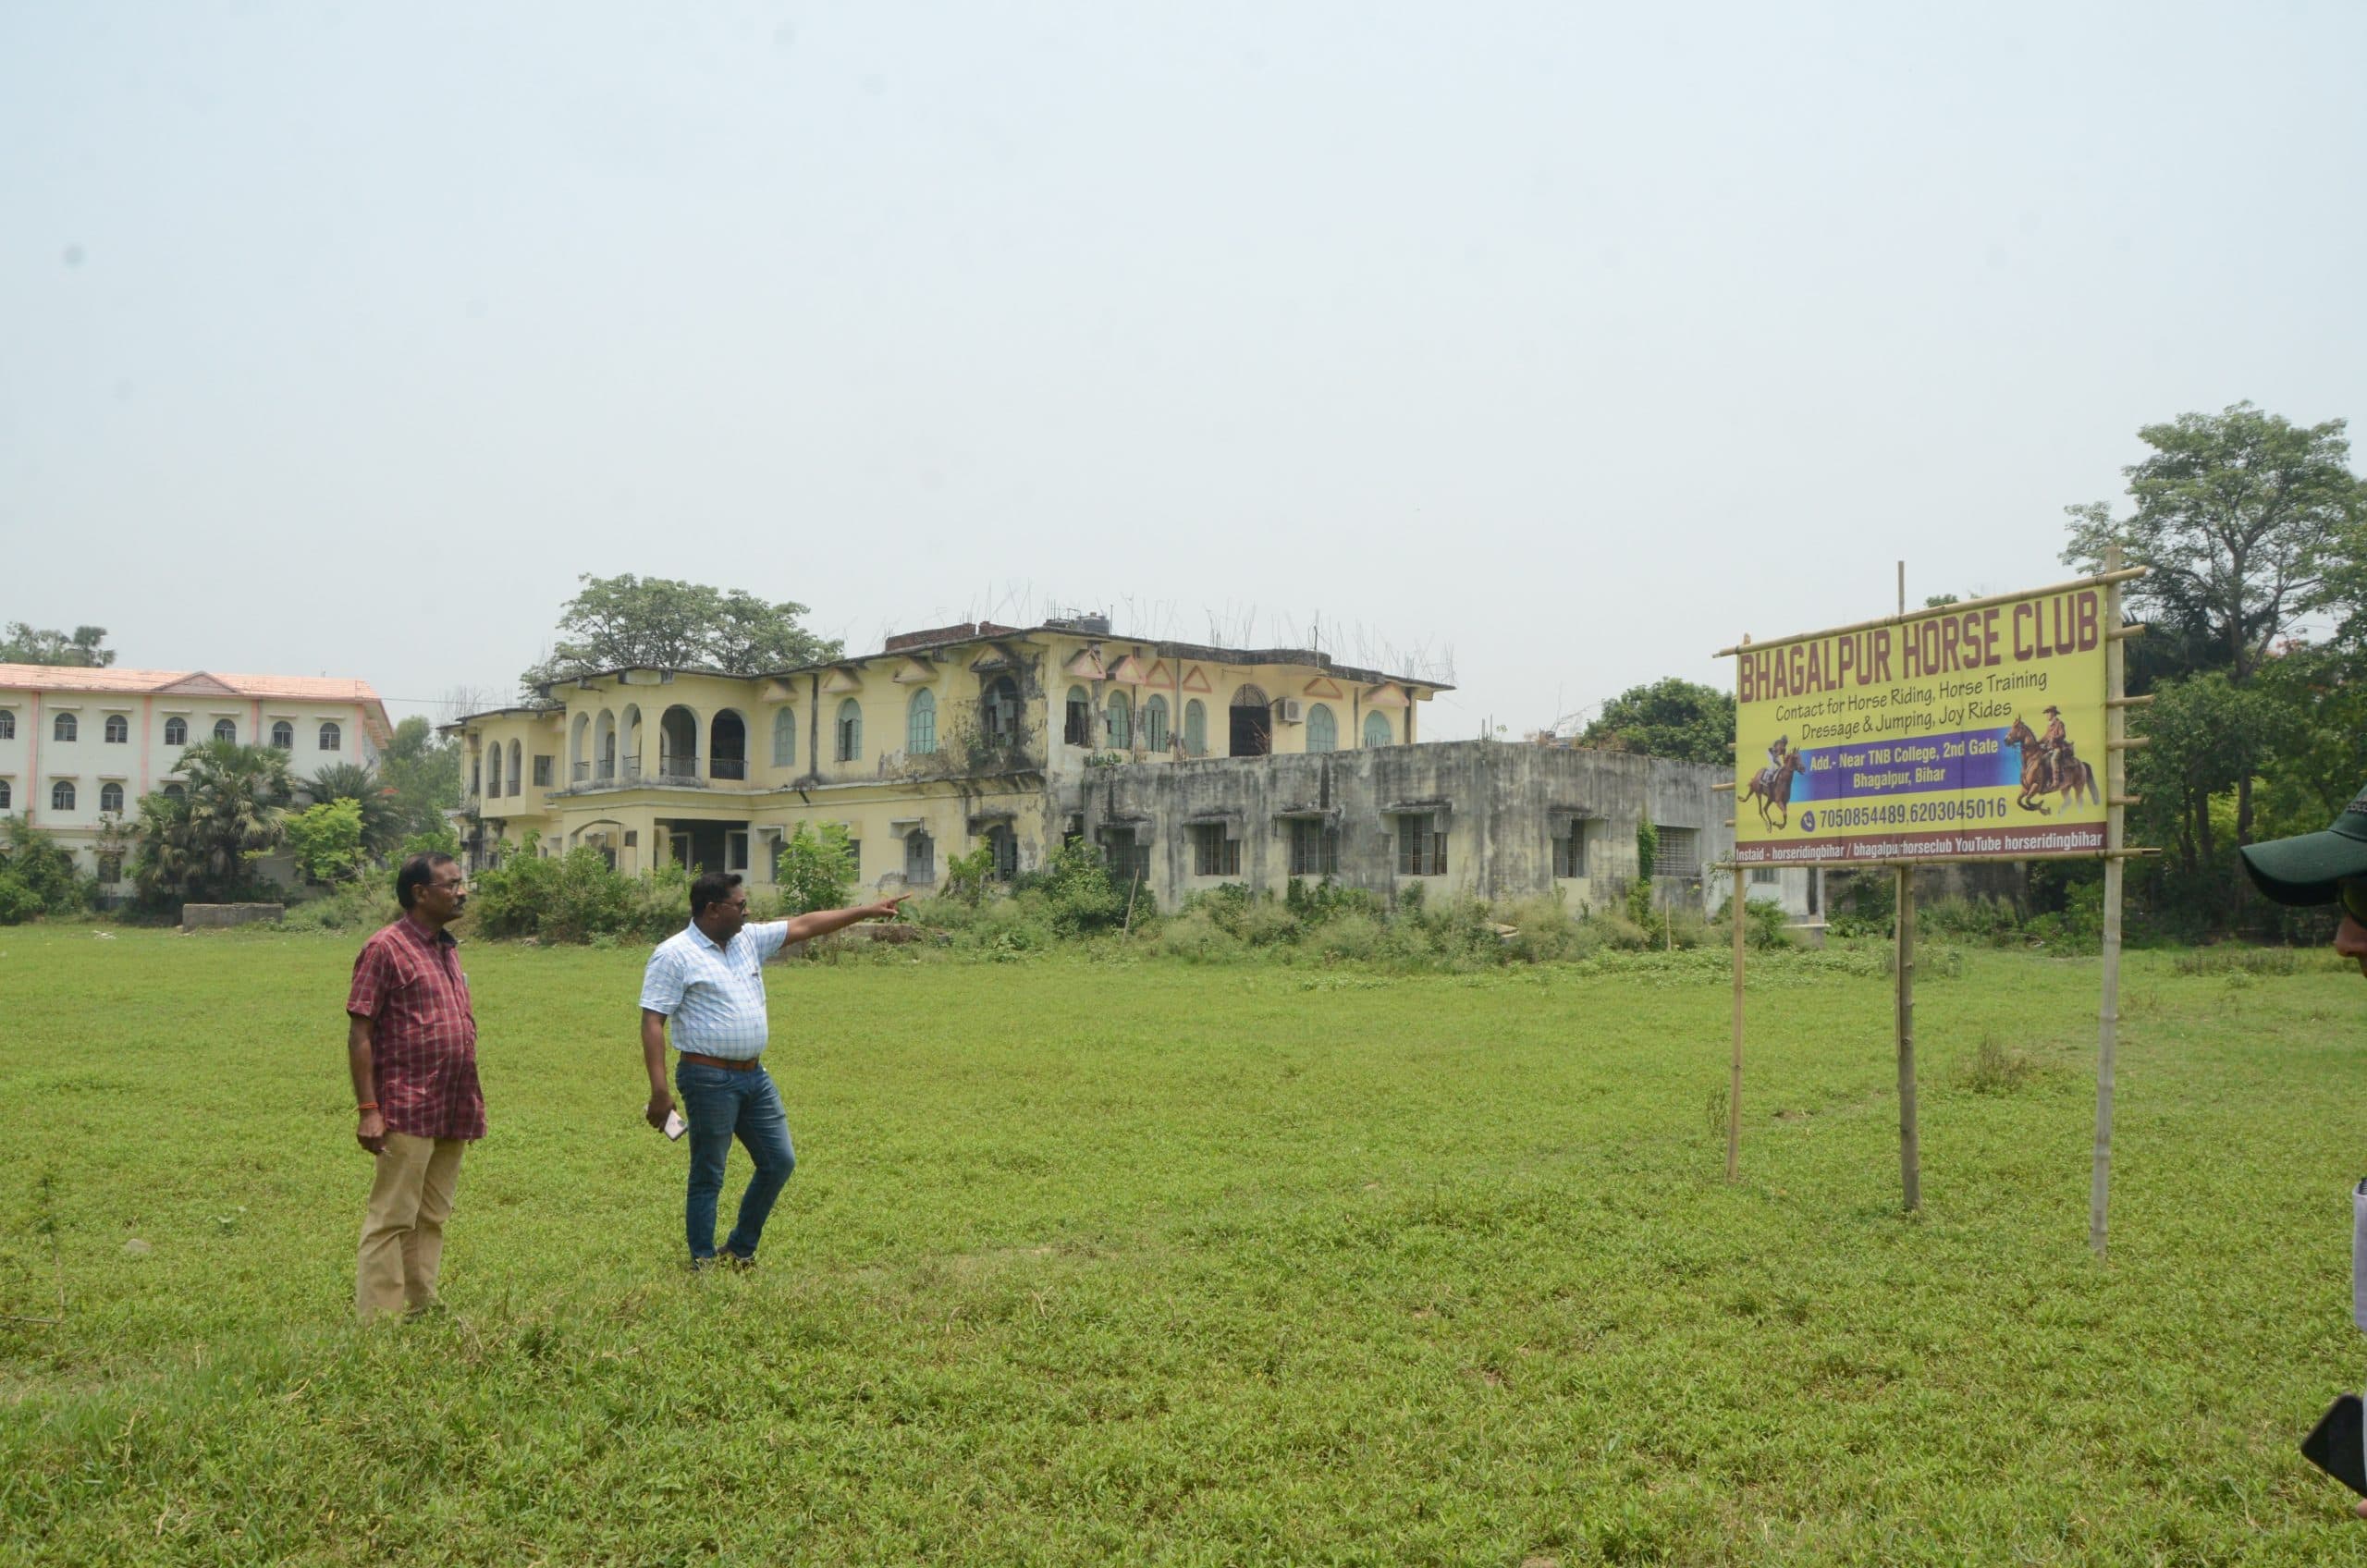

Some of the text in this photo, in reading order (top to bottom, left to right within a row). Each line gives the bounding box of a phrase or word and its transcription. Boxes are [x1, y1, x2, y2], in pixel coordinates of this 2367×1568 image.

[1740, 591, 2098, 703] BHAGALPUR HORSE CLUB
[1776, 670, 2047, 721] Contact for Horse Riding, Horse Training
[1802, 700, 2012, 741] Dressage & Jumping, Joy Rides
[1839, 751, 1865, 768] Near
[1868, 748, 1891, 766] TNB
[1895, 744, 1940, 764] College,
[1944, 741, 1966, 759] 2nd
[1968, 738, 1998, 754] Gate
[1853, 766, 1946, 790] Bhagalpur, Bihar
[1735, 847, 1764, 861] Instaid
[1772, 844, 1844, 861] horseridingbihar
[1955, 836, 2002, 852] YouTube
[2005, 831, 2103, 851] horseridingbihar
